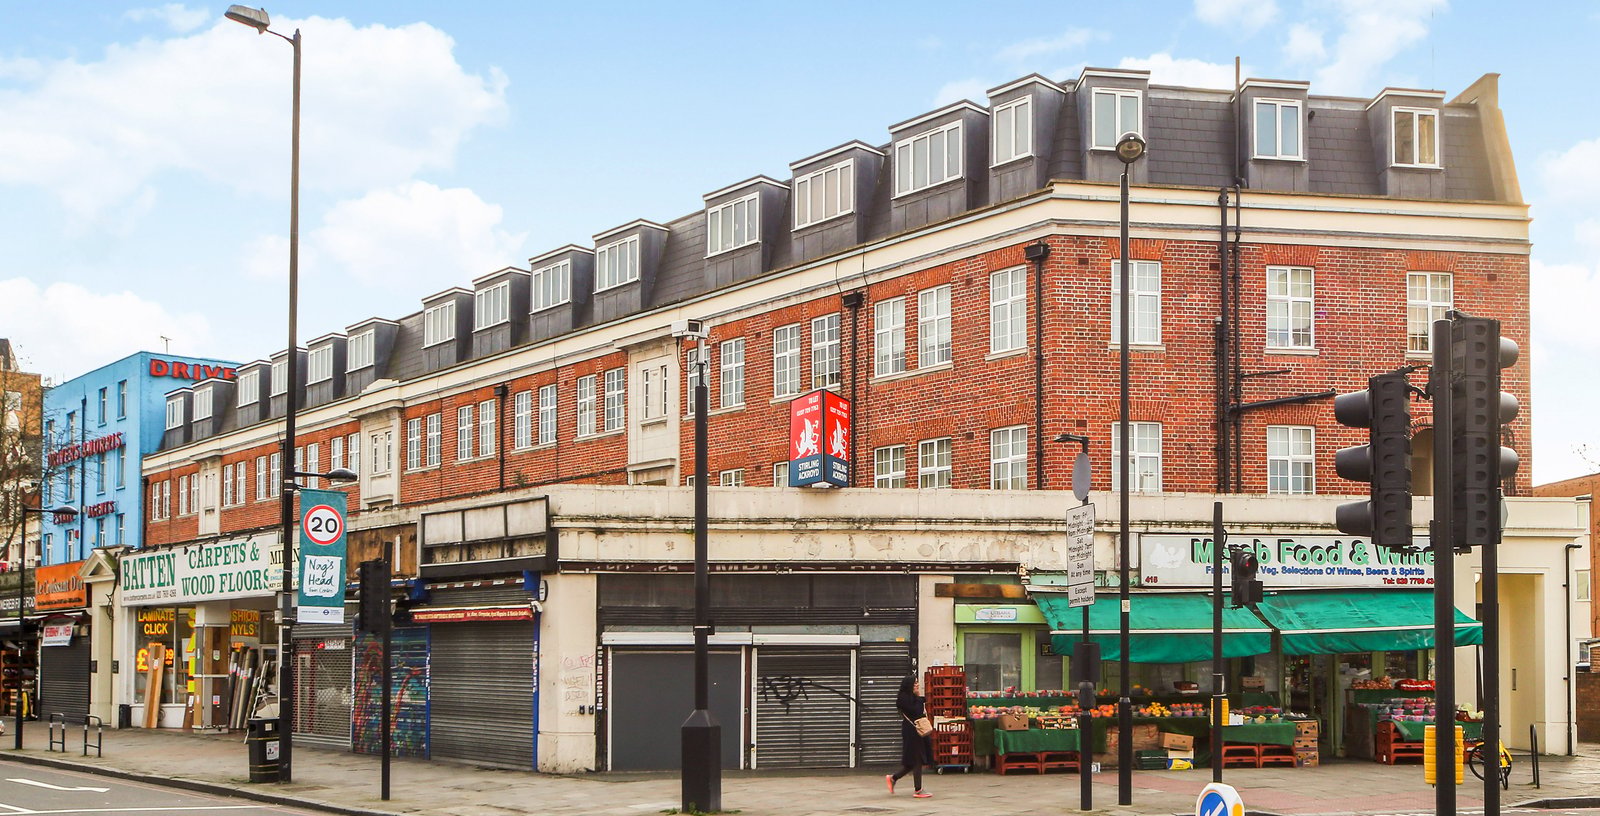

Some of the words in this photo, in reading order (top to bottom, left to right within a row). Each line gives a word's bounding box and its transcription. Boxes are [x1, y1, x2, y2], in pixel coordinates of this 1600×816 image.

[798, 459, 819, 472] STIRLING
[798, 468, 820, 480] ACKROYD
[312, 516, 338, 533] 20
[188, 543, 246, 569] CARPETS
[250, 542, 260, 561] &
[1278, 539, 1342, 565] Food
[1349, 540, 1370, 565] &
[123, 553, 176, 591] BATTEN
[310, 558, 334, 577] Nag's
[1281, 566, 1324, 576] Selections
[1326, 567, 1336, 576] Of
[1336, 567, 1364, 576] Wines,
[1366, 568, 1389, 576] Beers
[1391, 568, 1398, 576] &
[1399, 568, 1425, 577] Spirits
[182, 574, 214, 596] WOOD
[220, 568, 268, 593] FLOORS
[308, 574, 334, 586] Head
[138, 610, 174, 622] LAMINATE
[231, 610, 258, 622] SHION
[144, 623, 168, 634] CLICK
[232, 624, 254, 636] NYLS
